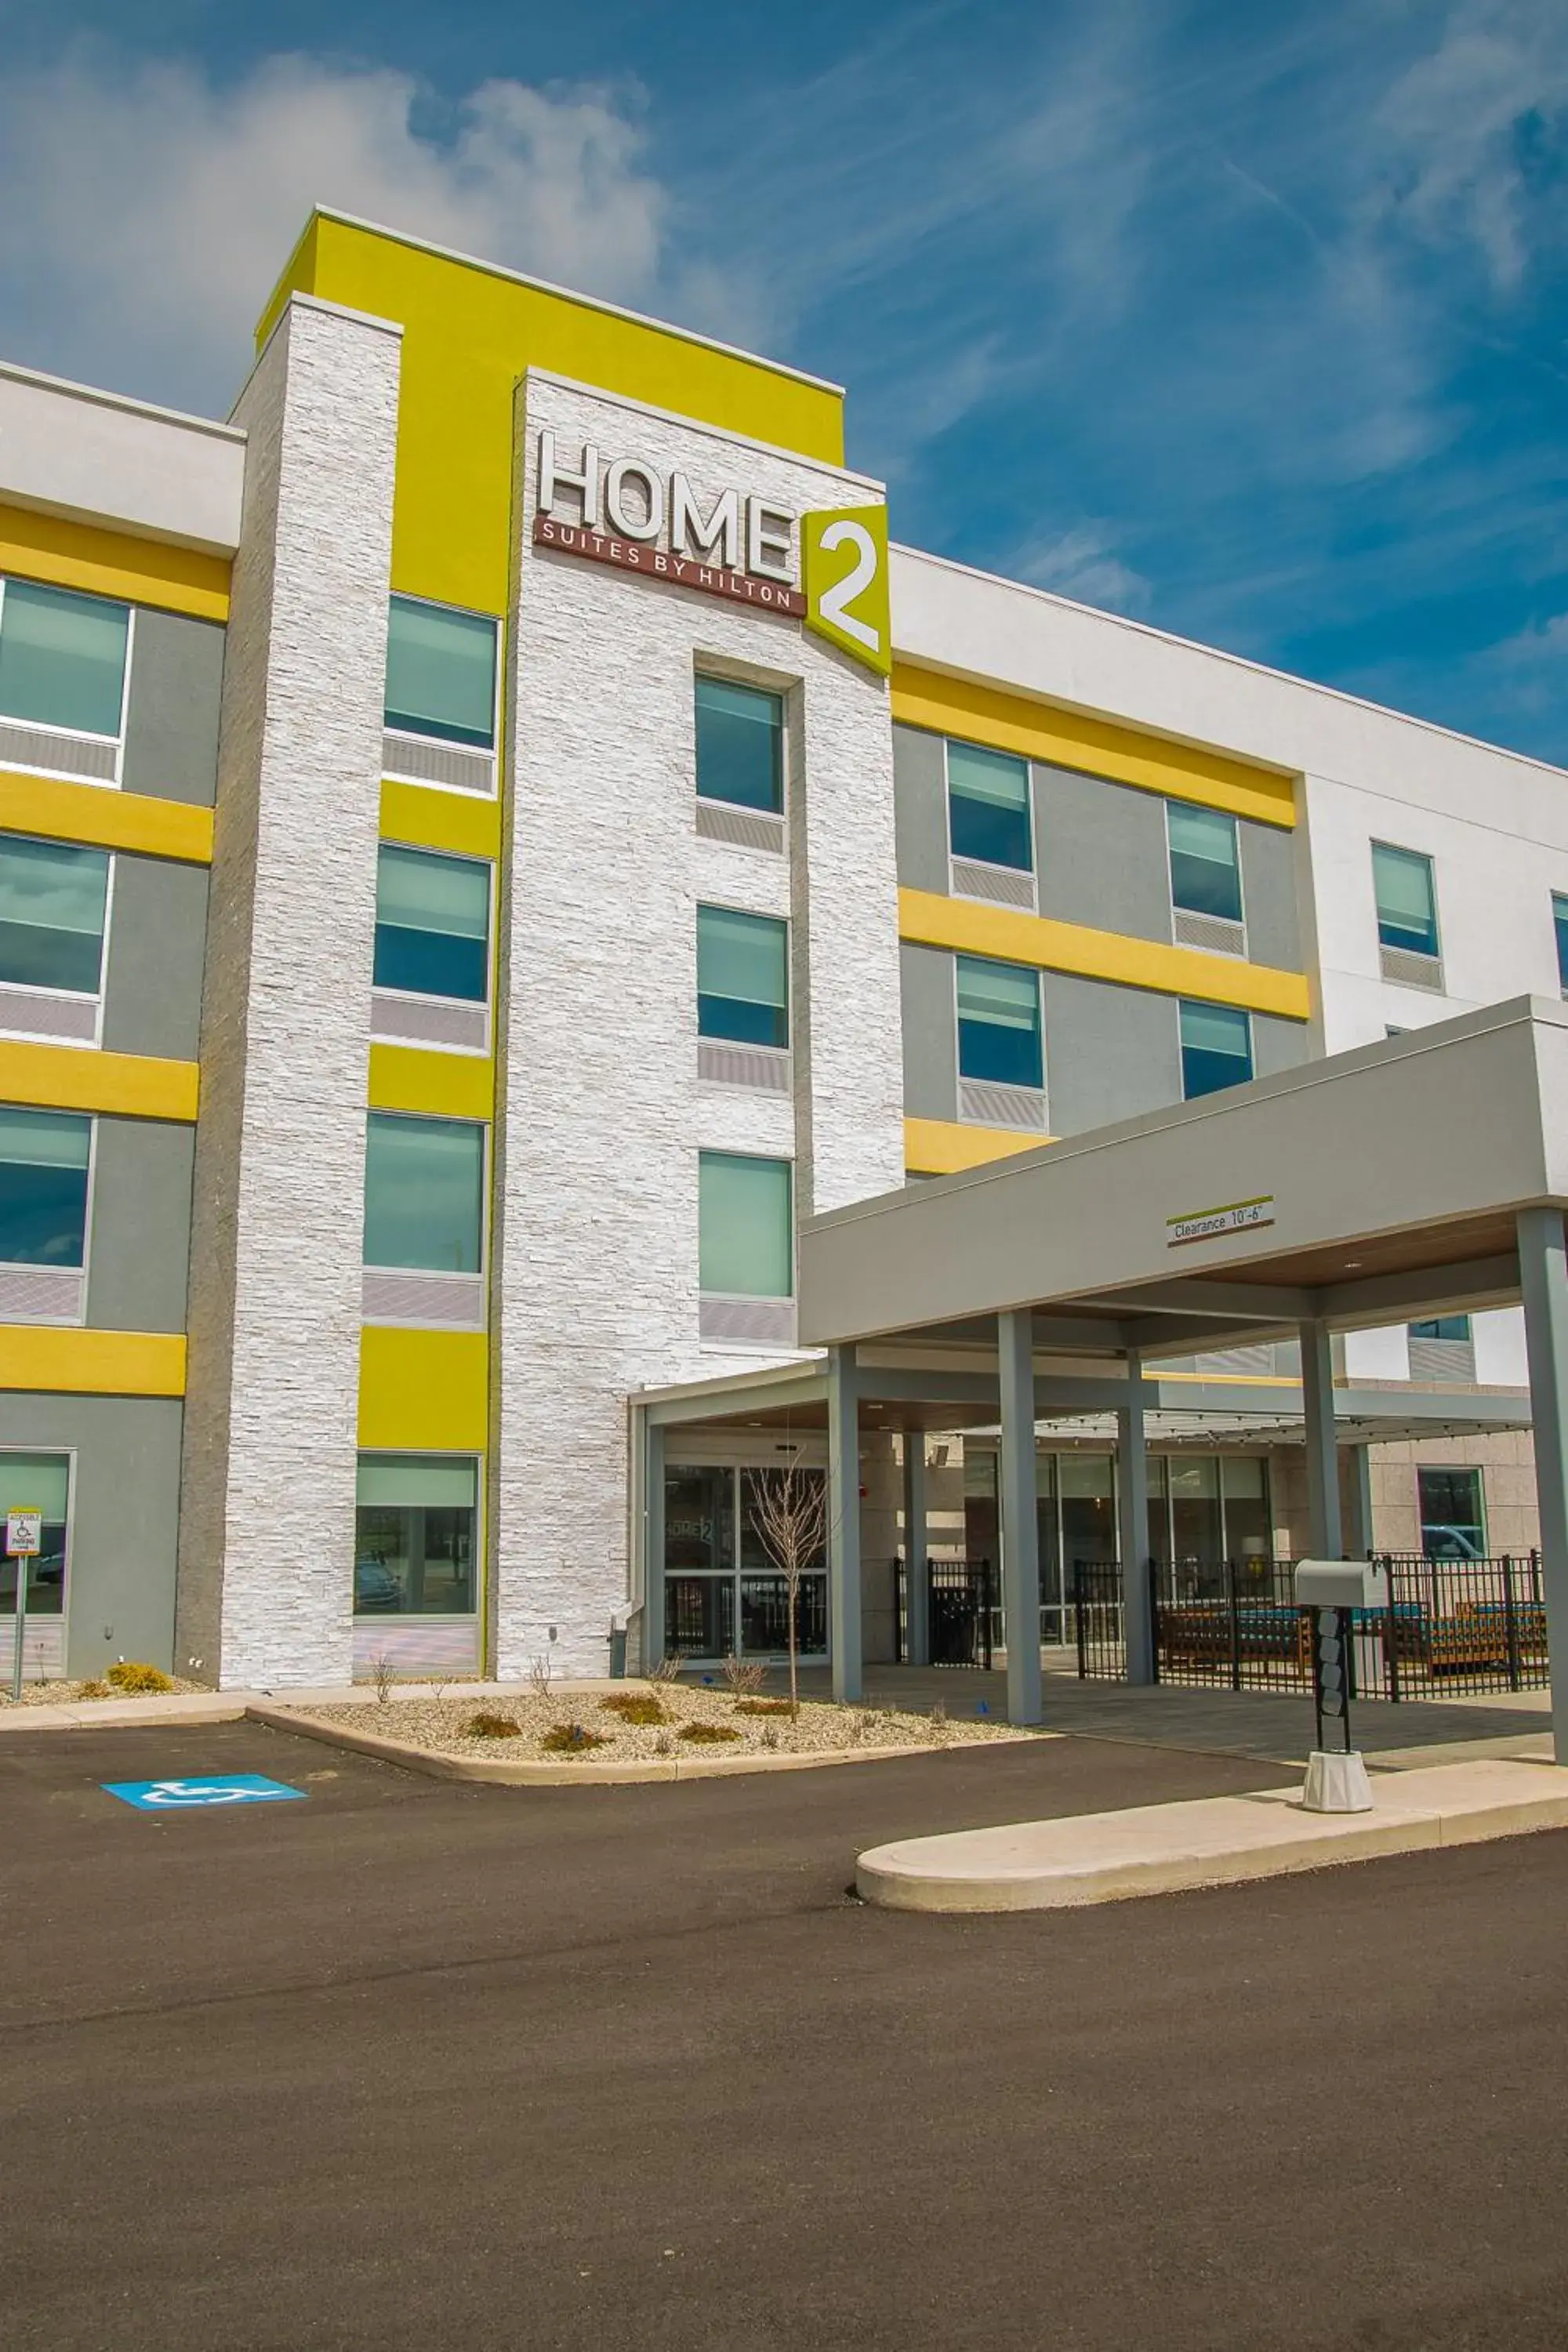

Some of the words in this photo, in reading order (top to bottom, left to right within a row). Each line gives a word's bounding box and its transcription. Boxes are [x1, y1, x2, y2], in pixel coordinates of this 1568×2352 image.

[538, 429, 797, 585] HOME
[819, 520, 879, 653] 2
[543, 523, 639, 564] SUITES
[655, 554, 685, 576] BY
[699, 568, 790, 608] HILTON
[1175, 1216, 1225, 1238] Clearance
